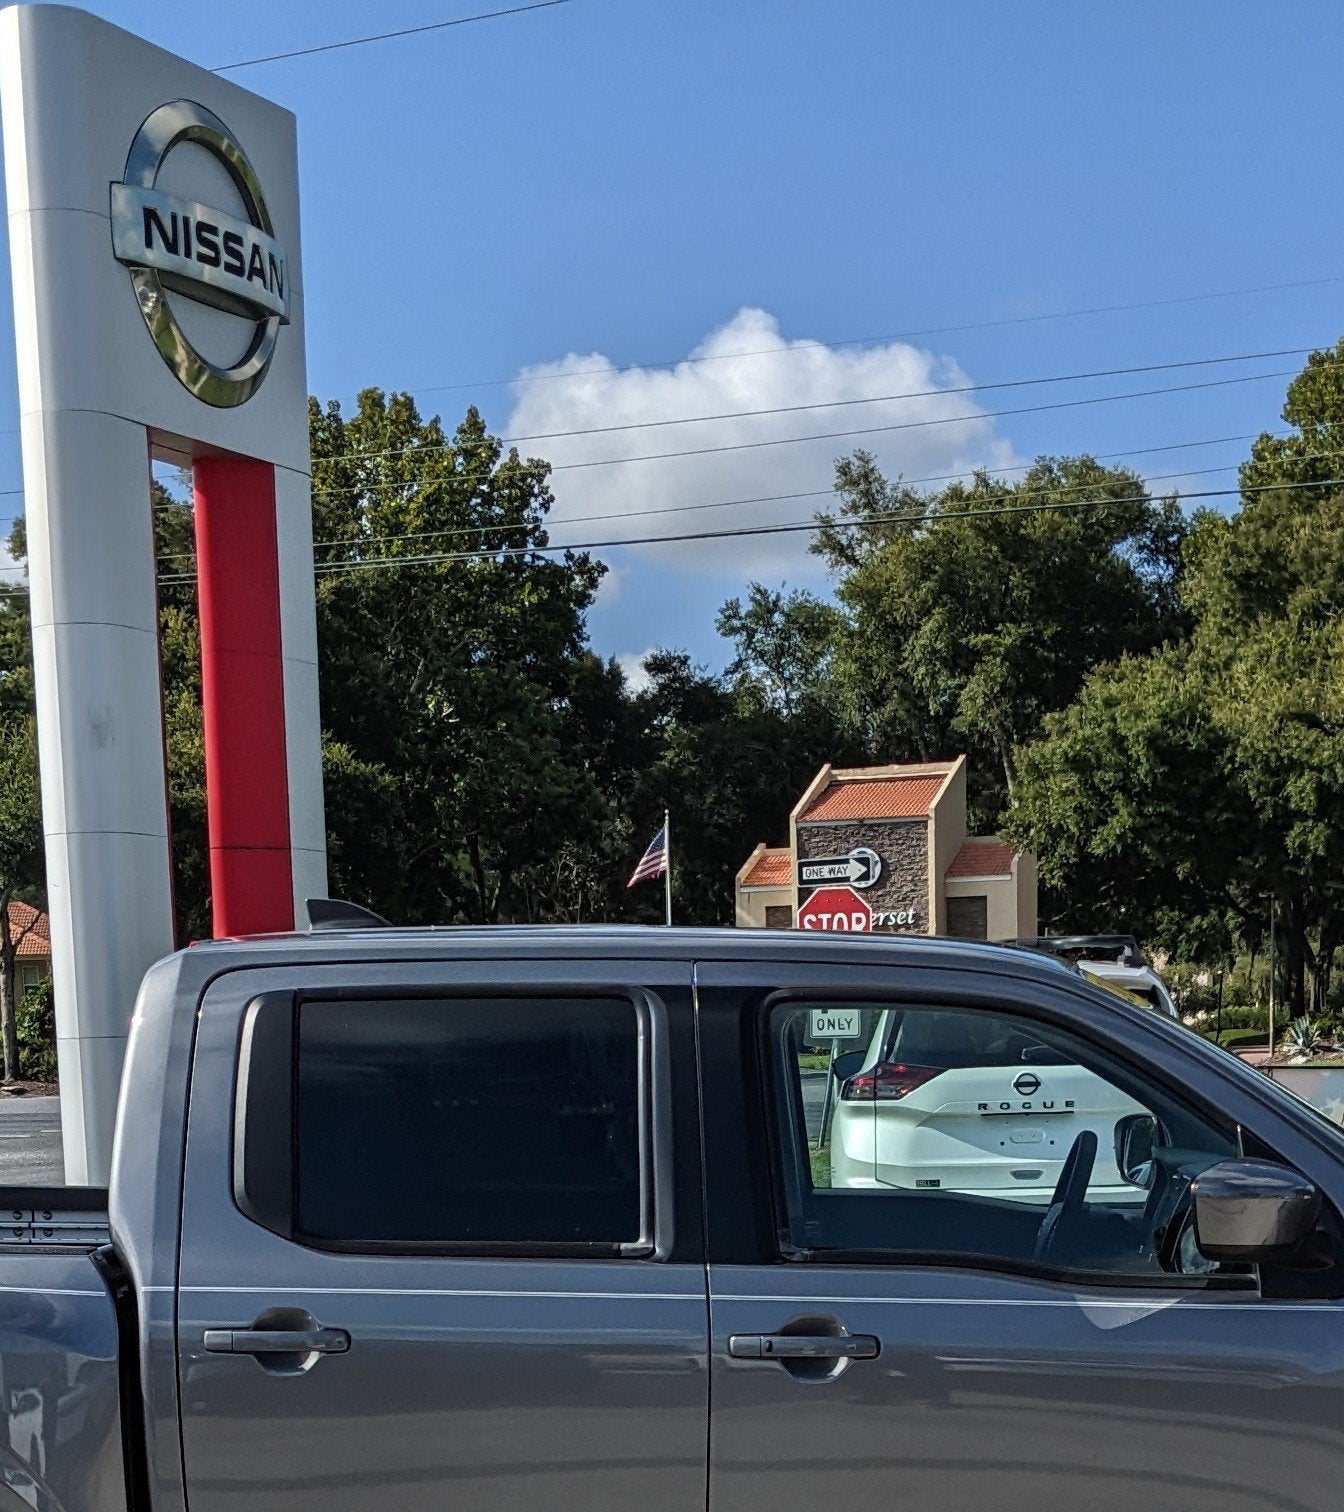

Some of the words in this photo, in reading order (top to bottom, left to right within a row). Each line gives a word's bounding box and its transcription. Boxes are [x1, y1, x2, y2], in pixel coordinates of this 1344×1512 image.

[142, 206, 285, 301] NISSAN
[805, 867, 825, 878] ONE
[828, 865, 849, 876] WAY
[803, 912, 867, 931] STOP
[816, 1017, 854, 1031] ONLY
[977, 1100, 1075, 1111] ROGUE
